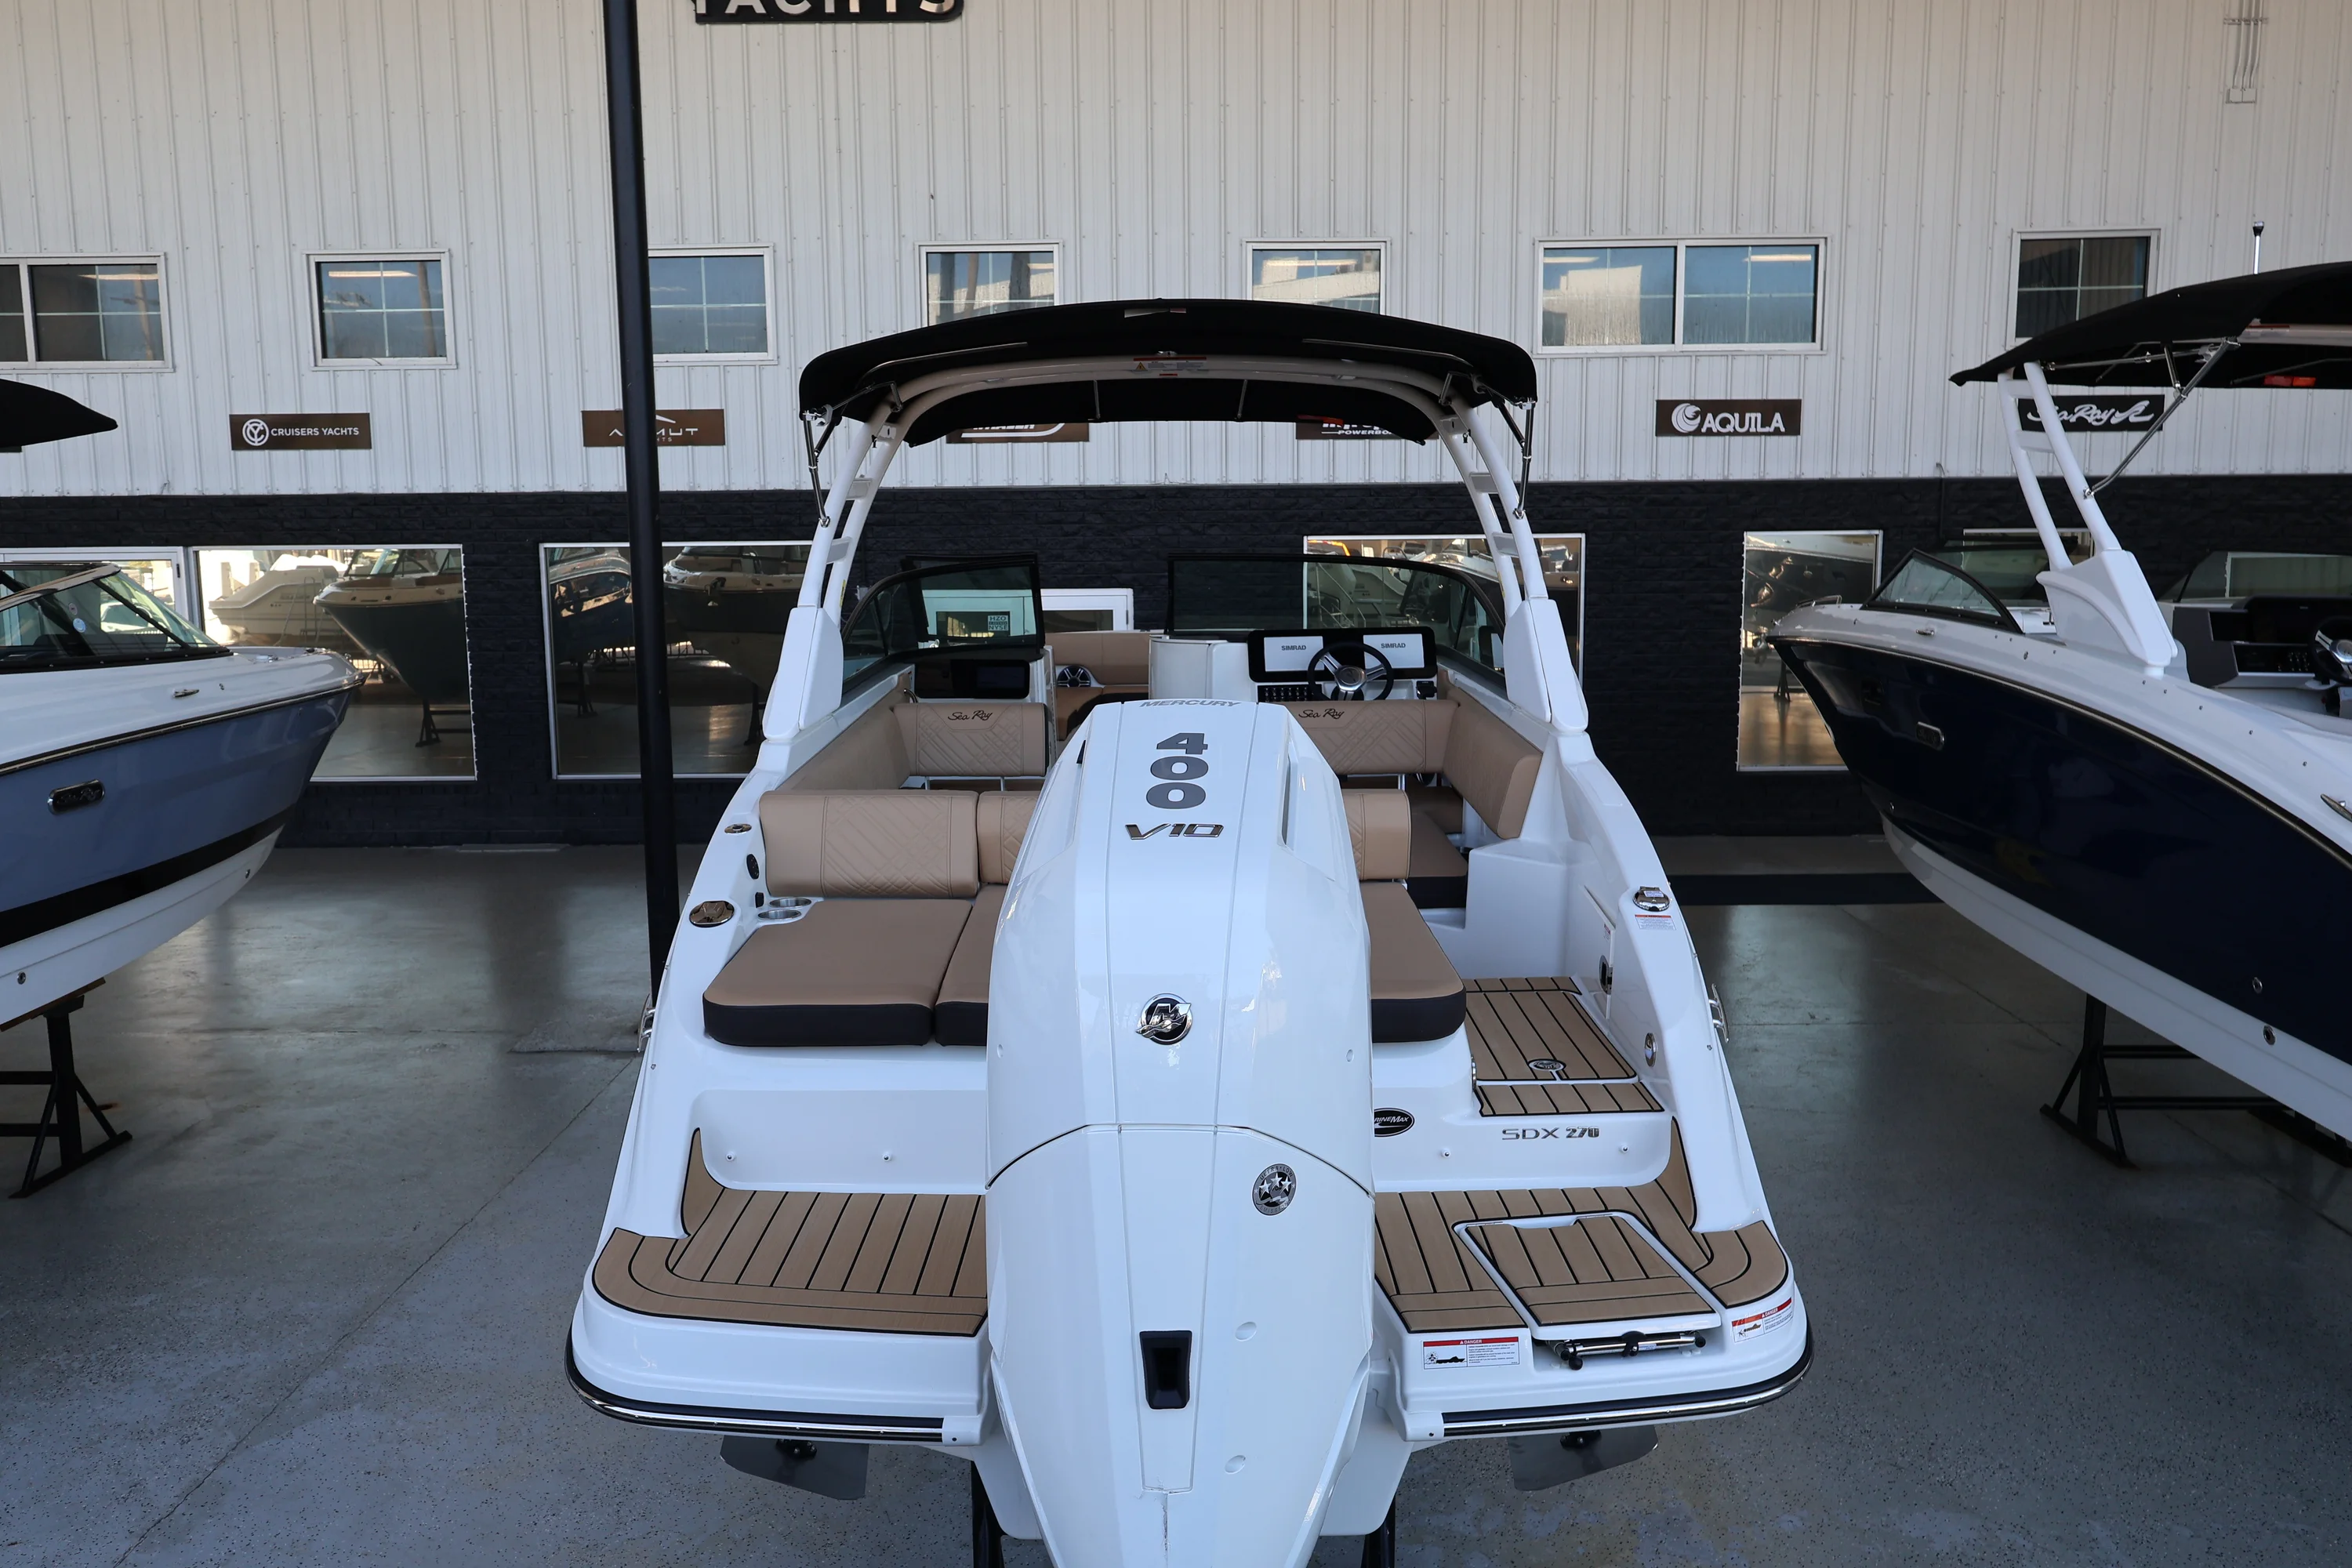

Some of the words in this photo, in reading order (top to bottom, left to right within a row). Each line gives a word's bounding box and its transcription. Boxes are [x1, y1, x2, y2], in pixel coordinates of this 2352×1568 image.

[1701, 412, 1785, 433] AQUILA
[947, 711, 970, 720] Sea
[971, 710, 993, 720] Ray
[1298, 709, 1321, 718] Sea
[1323, 708, 1345, 720] Ray
[1125, 823, 1225, 840] V10
[1501, 1127, 1560, 1141] SDX
[1566, 1127, 1600, 1138] 270
